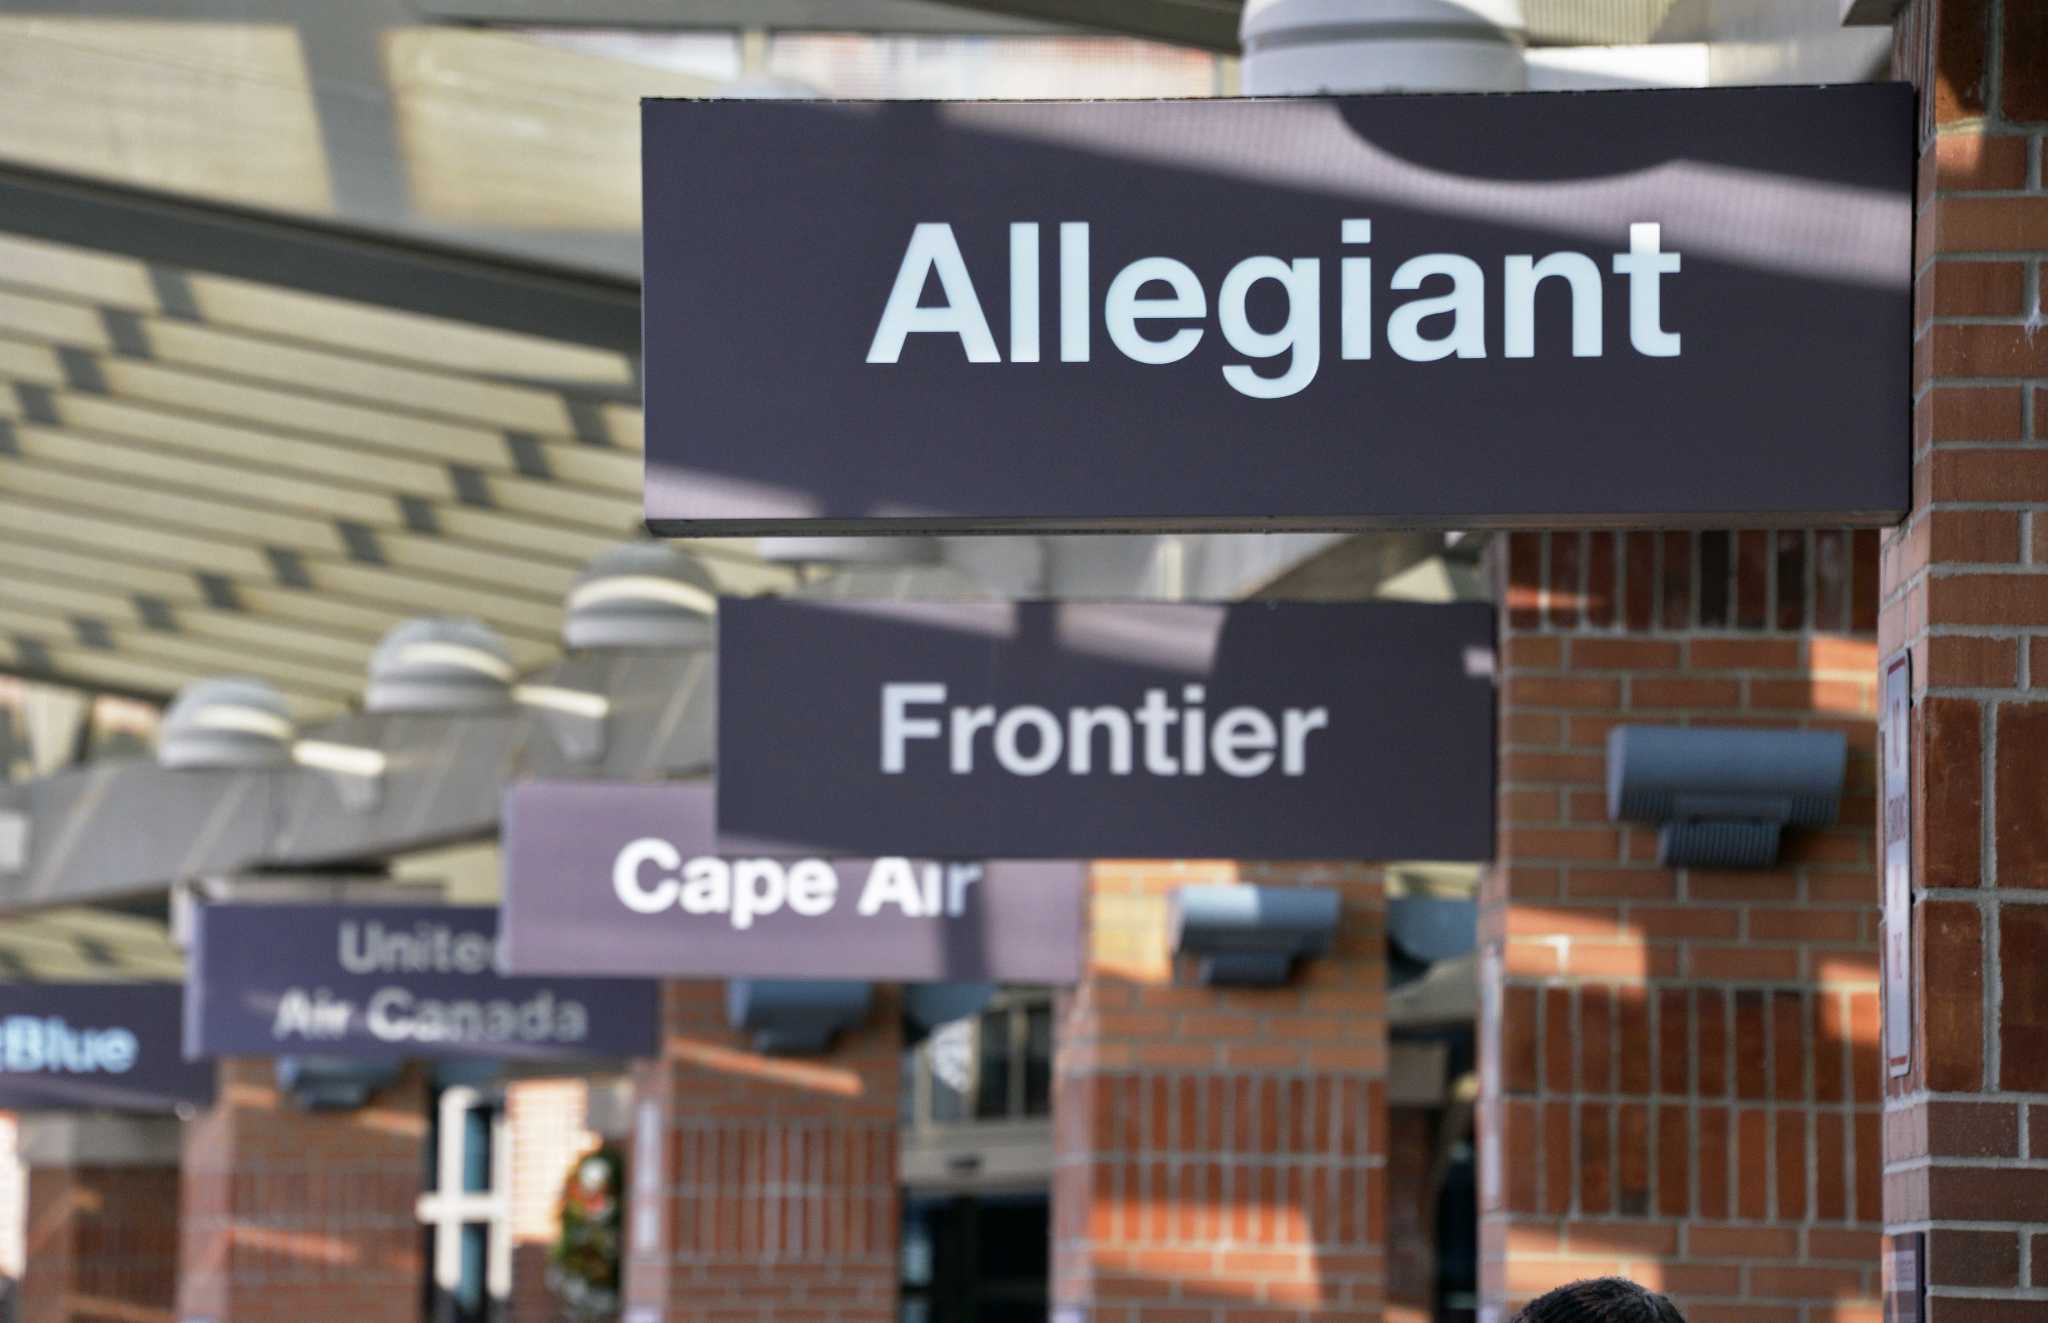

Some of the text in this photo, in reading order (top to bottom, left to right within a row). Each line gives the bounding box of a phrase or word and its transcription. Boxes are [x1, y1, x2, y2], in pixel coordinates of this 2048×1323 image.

[866, 218, 1681, 398] Allegiant
[881, 683, 1328, 777] Frontier
[612, 837, 983, 929] Cape Air
[0, 1014, 139, 1074] Blue
[272, 985, 588, 1043] Air Canada
